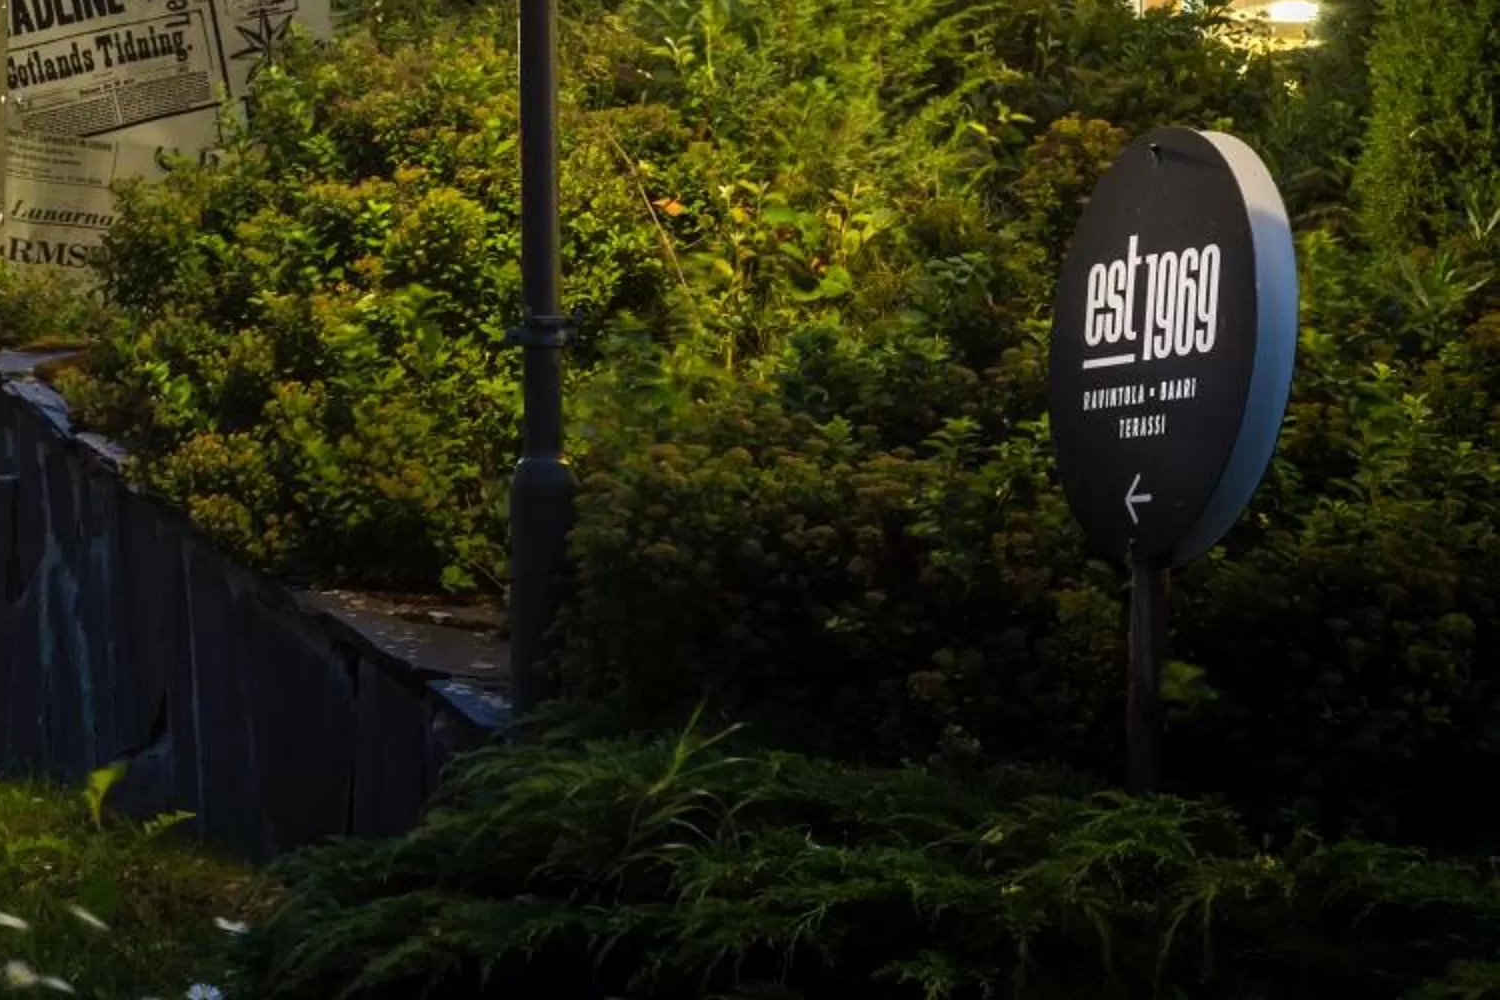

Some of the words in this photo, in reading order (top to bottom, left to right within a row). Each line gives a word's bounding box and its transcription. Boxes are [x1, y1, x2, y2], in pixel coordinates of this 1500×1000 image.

[1083, 384, 1146, 411] RAVINTOLA
[1160, 377, 1197, 401] BAARI
[1119, 413, 1166, 439] TERASSI
